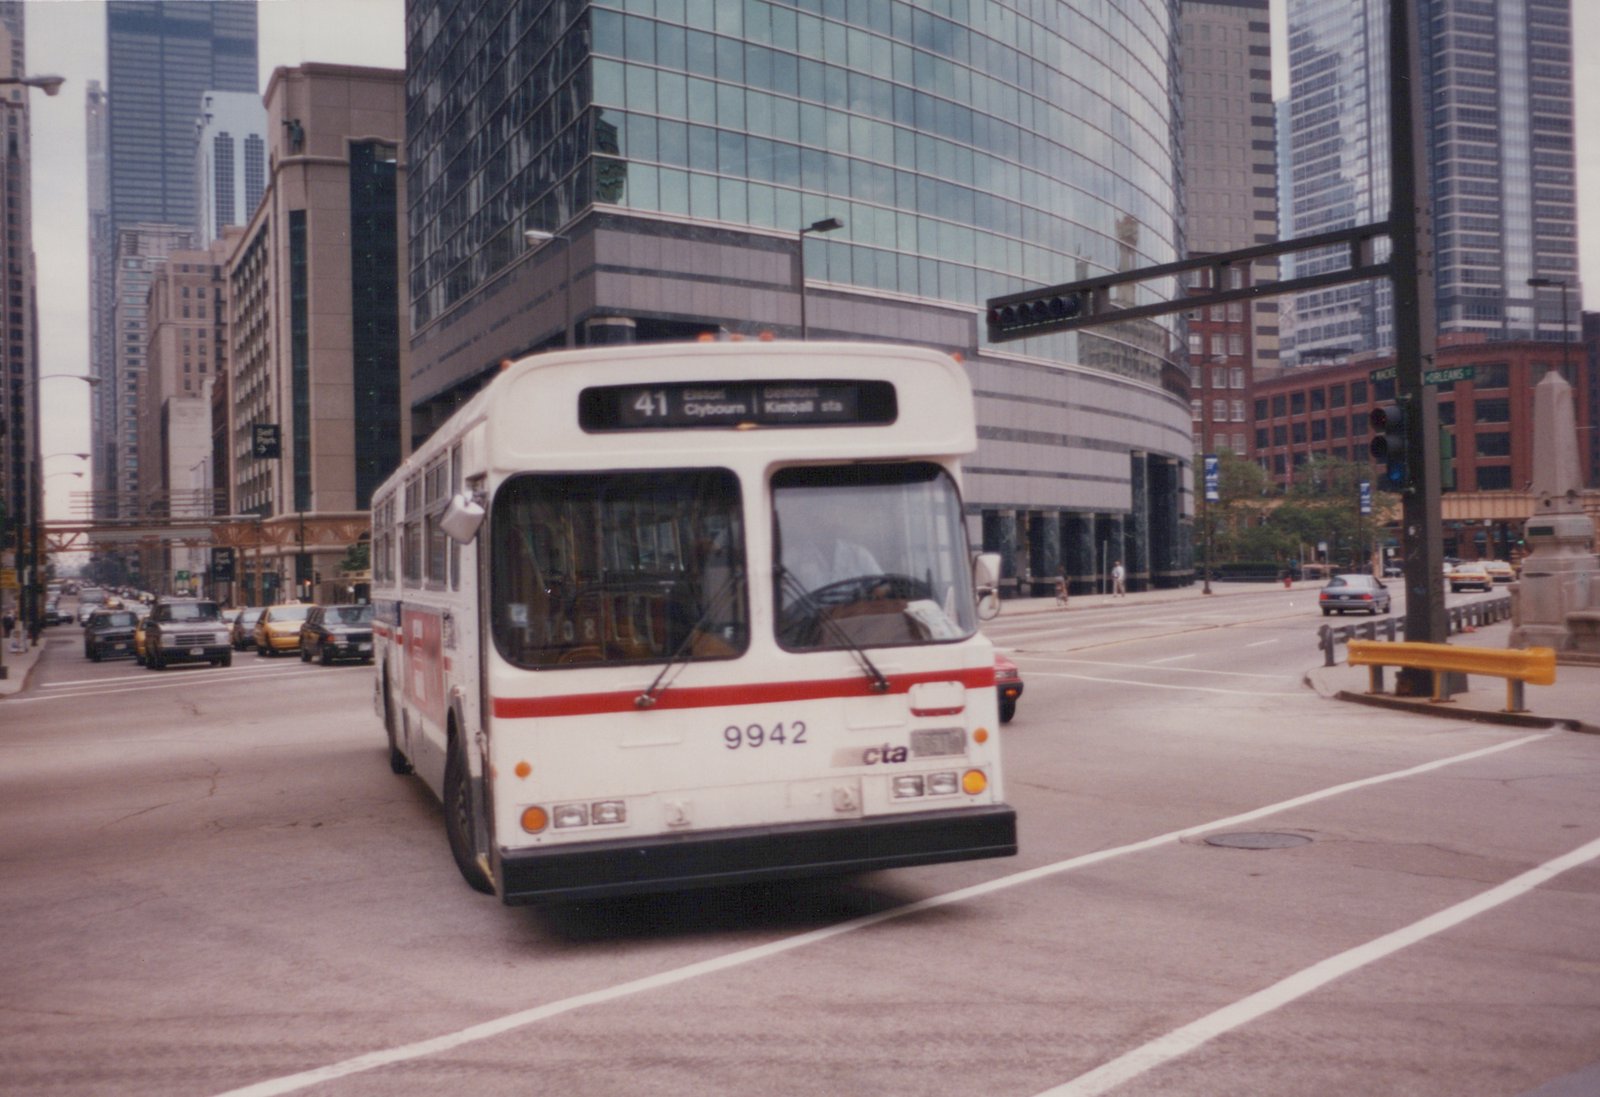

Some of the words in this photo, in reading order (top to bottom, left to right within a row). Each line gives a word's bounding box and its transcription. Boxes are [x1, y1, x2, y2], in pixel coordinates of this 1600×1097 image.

[634, 389, 668, 416] 41
[684, 402, 746, 418] Clybourn
[723, 720, 808, 750] 9942
[862, 742, 909, 766] cta
